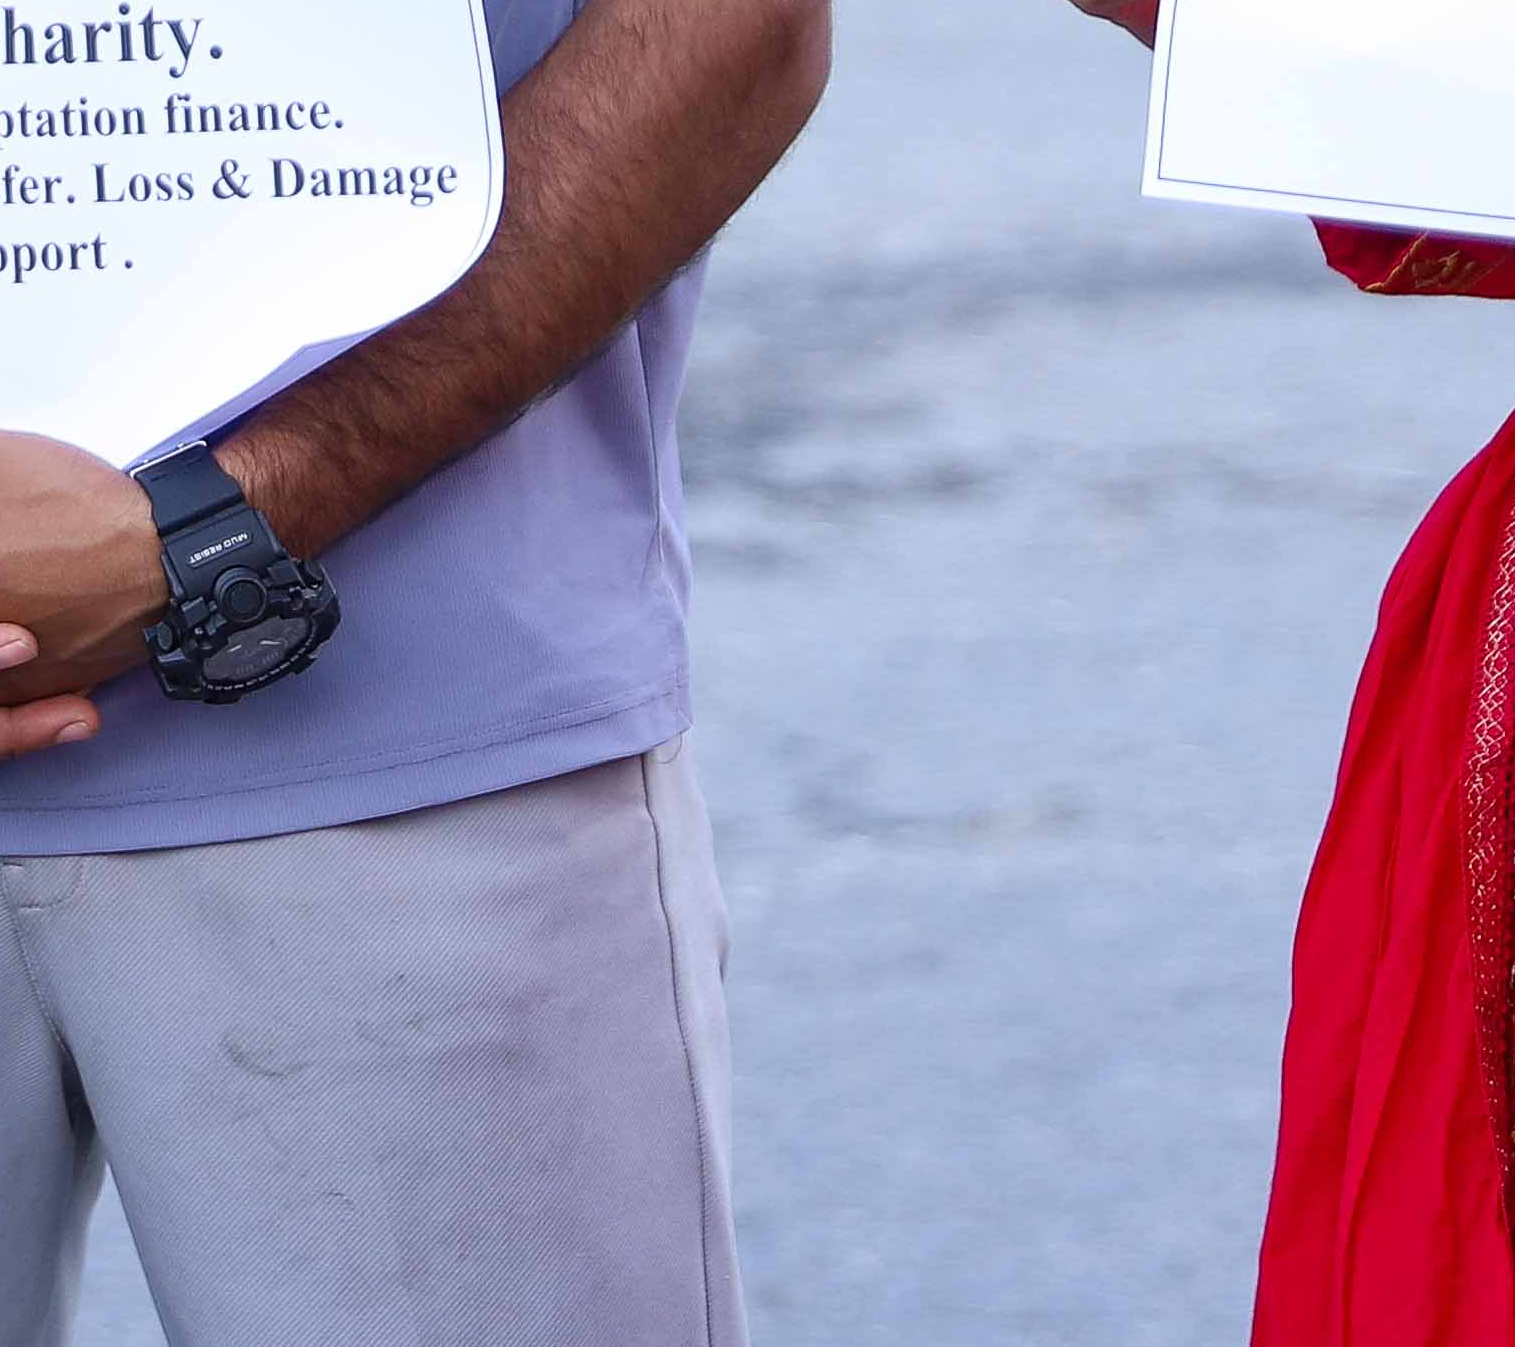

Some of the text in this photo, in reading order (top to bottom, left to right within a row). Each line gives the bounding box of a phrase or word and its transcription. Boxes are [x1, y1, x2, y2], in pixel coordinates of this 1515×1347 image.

[164, 92, 344, 135] finance.
[92, 161, 195, 203] Loss
[211, 158, 252, 200] &
[269, 156, 459, 206] Damage
[223, 532, 248, 547] MUD
